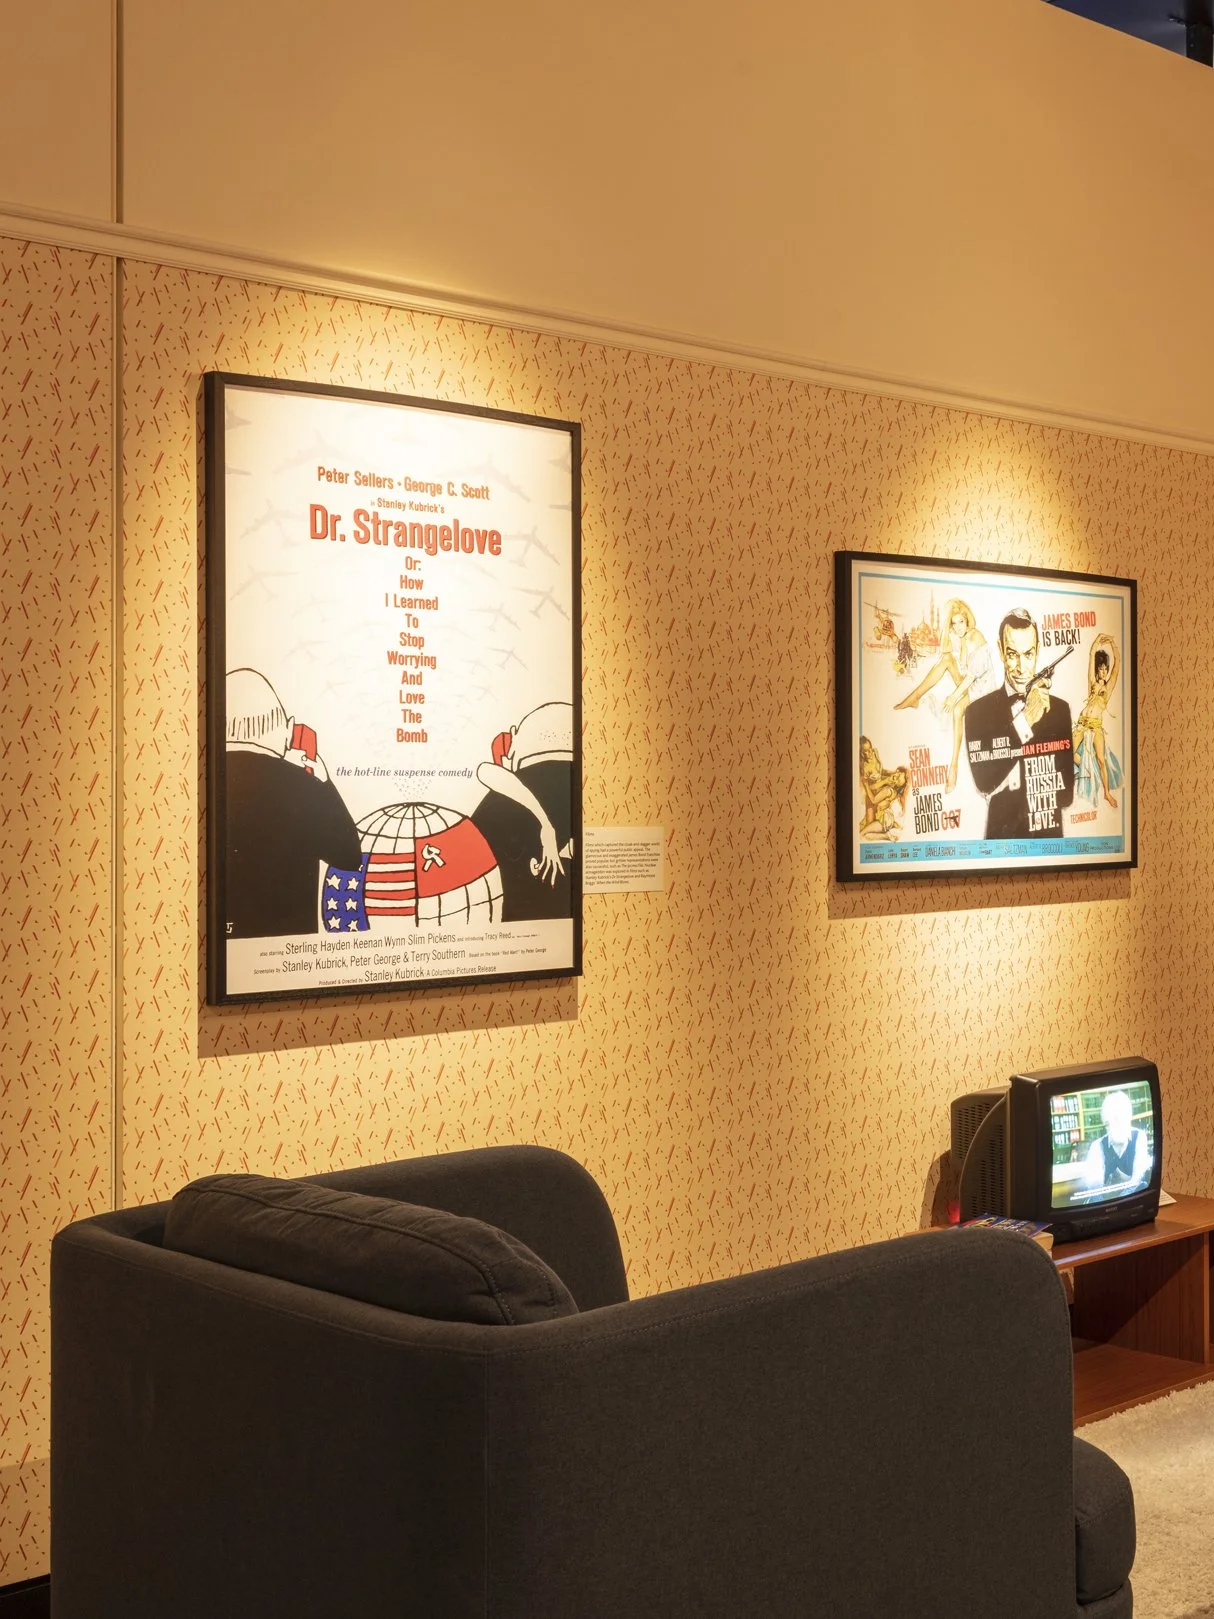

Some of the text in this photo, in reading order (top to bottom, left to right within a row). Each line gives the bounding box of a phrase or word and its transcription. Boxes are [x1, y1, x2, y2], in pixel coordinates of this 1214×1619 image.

[317, 466, 491, 500] Peter Sellers George C. Scott
[377, 497, 406, 512] Stanley
[408, 500, 445, 514] Kubrick's
[309, 503, 502, 556] Dr. Strangelove
[399, 574, 424, 590] How
[384, 592, 439, 611] I Learned
[405, 613, 419, 629] To
[1041, 611, 1097, 630] JAMES BOND
[399, 632, 425, 649] Stop
[1042, 628, 1081, 647] IS BACK!
[386, 650, 437, 669] Worrying
[401, 671, 423, 686] And
[399, 689, 425, 705] Love
[401, 709, 422, 724] The
[396, 728, 428, 743] Bomb
[1022, 739, 1070, 756] IAN FLEMING'S
[909, 747, 930, 769] SEAN
[1024, 754, 1057, 777] FROM
[336, 767, 473, 779] the hot-line suspense comedy
[910, 765, 949, 788] CONNERY
[912, 787, 920, 796] as
[1025, 771, 1066, 795] RUSSIA
[914, 792, 943, 815] JAMES
[1026, 791, 1058, 813] WITH
[914, 808, 961, 835] BOND 007
[1028, 809, 1060, 832] LOVE.
[285, 942, 318, 955] Sterling
[320, 939, 351, 953] Hayden
[353, 937, 383, 949] Keenan
[384, 935, 406, 948] Wynn
[407, 933, 425, 946] Slim
[427, 932, 456, 944] Pickens
[485, 932, 498, 940] Tracy
[499, 931, 512, 940] Reed
[282, 960, 313, 973] Stanley
[315, 956, 348, 970] Kubrick,
[350, 955, 371, 967] Peter
[373, 953, 401, 966] George
[403, 954, 409, 963] &
[411, 951, 431, 964] Terry
[432, 948, 466, 961] Southern
[364, 970, 393, 982] Stanley
[396, 967, 424, 979] Kubrick
[431, 967, 455, 977] Columbia
[456, 966, 477, 974] Pictures
[477, 965, 497, 973] Release
